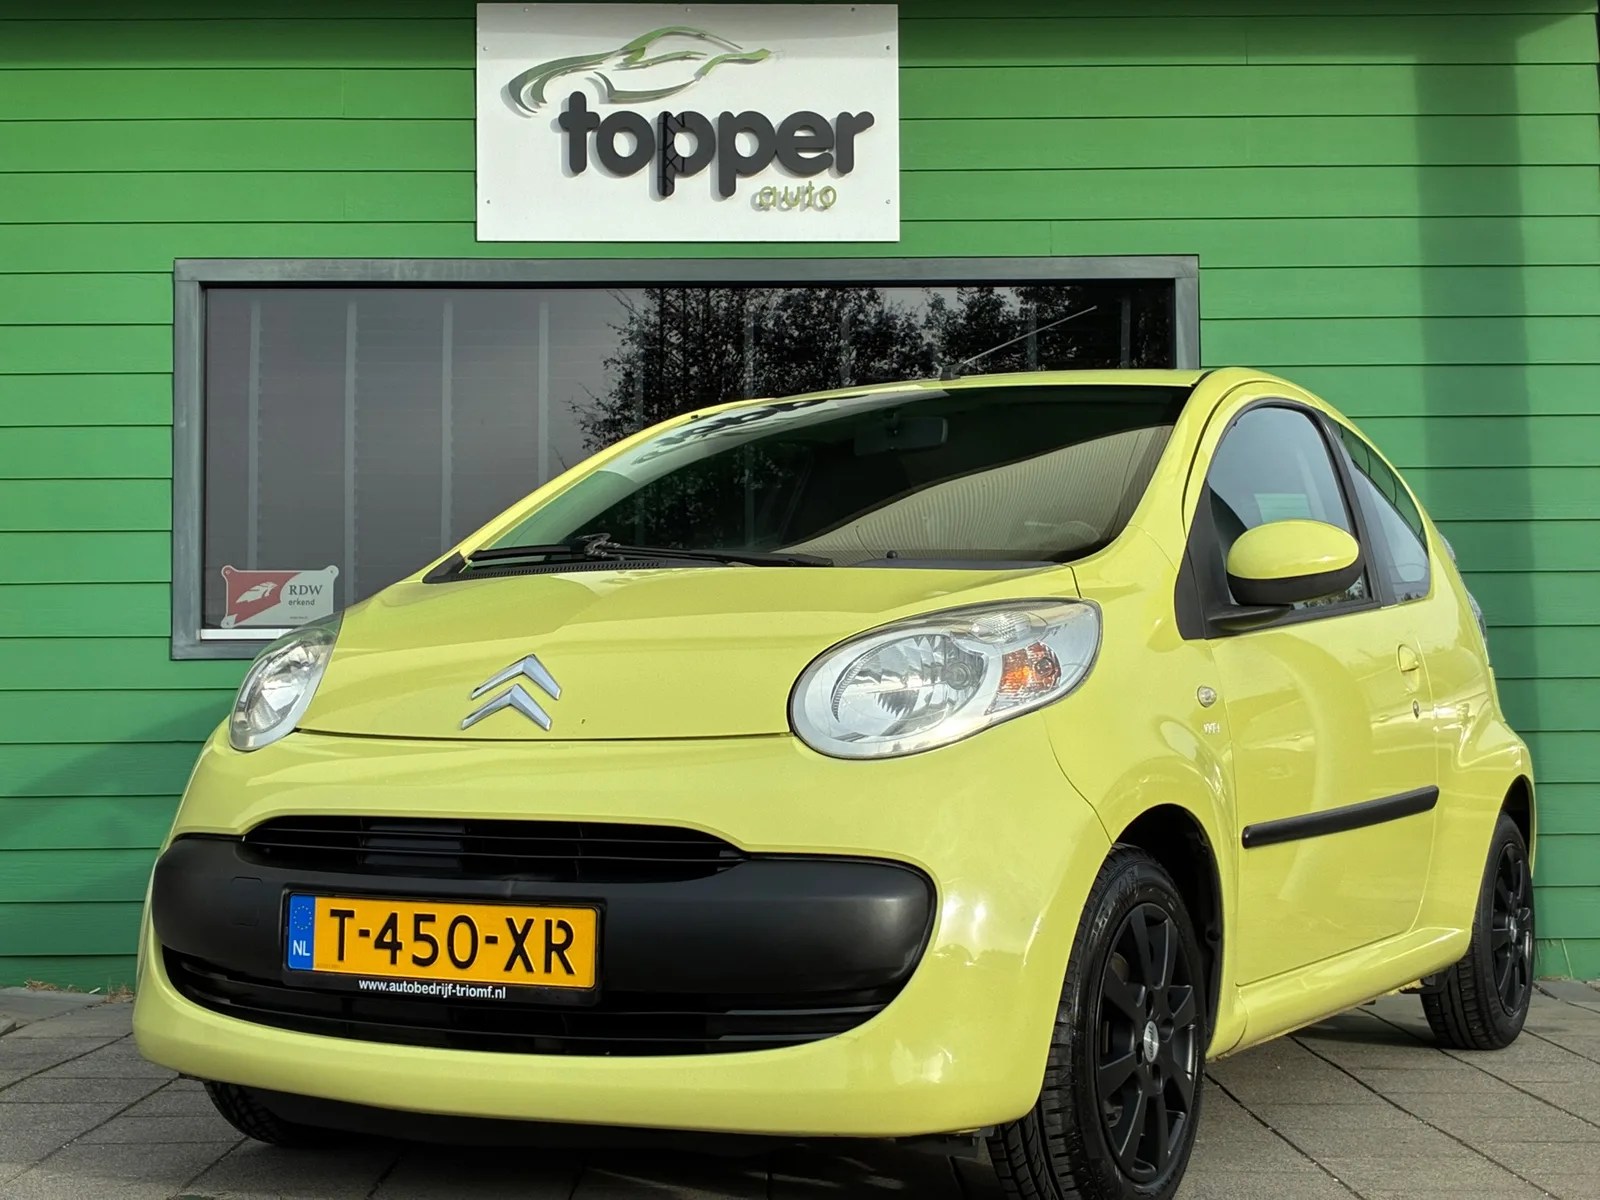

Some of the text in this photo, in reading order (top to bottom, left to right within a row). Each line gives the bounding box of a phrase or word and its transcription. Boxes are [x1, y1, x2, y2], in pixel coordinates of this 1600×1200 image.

[558, 91, 875, 198] topper
[758, 180, 838, 209] auto
[289, 585, 323, 595] RDW
[292, 939, 311, 957] NL
[329, 907, 576, 976] T-450-XR
[358, 979, 507, 1000] www.autobedrijf-triomf.nl
